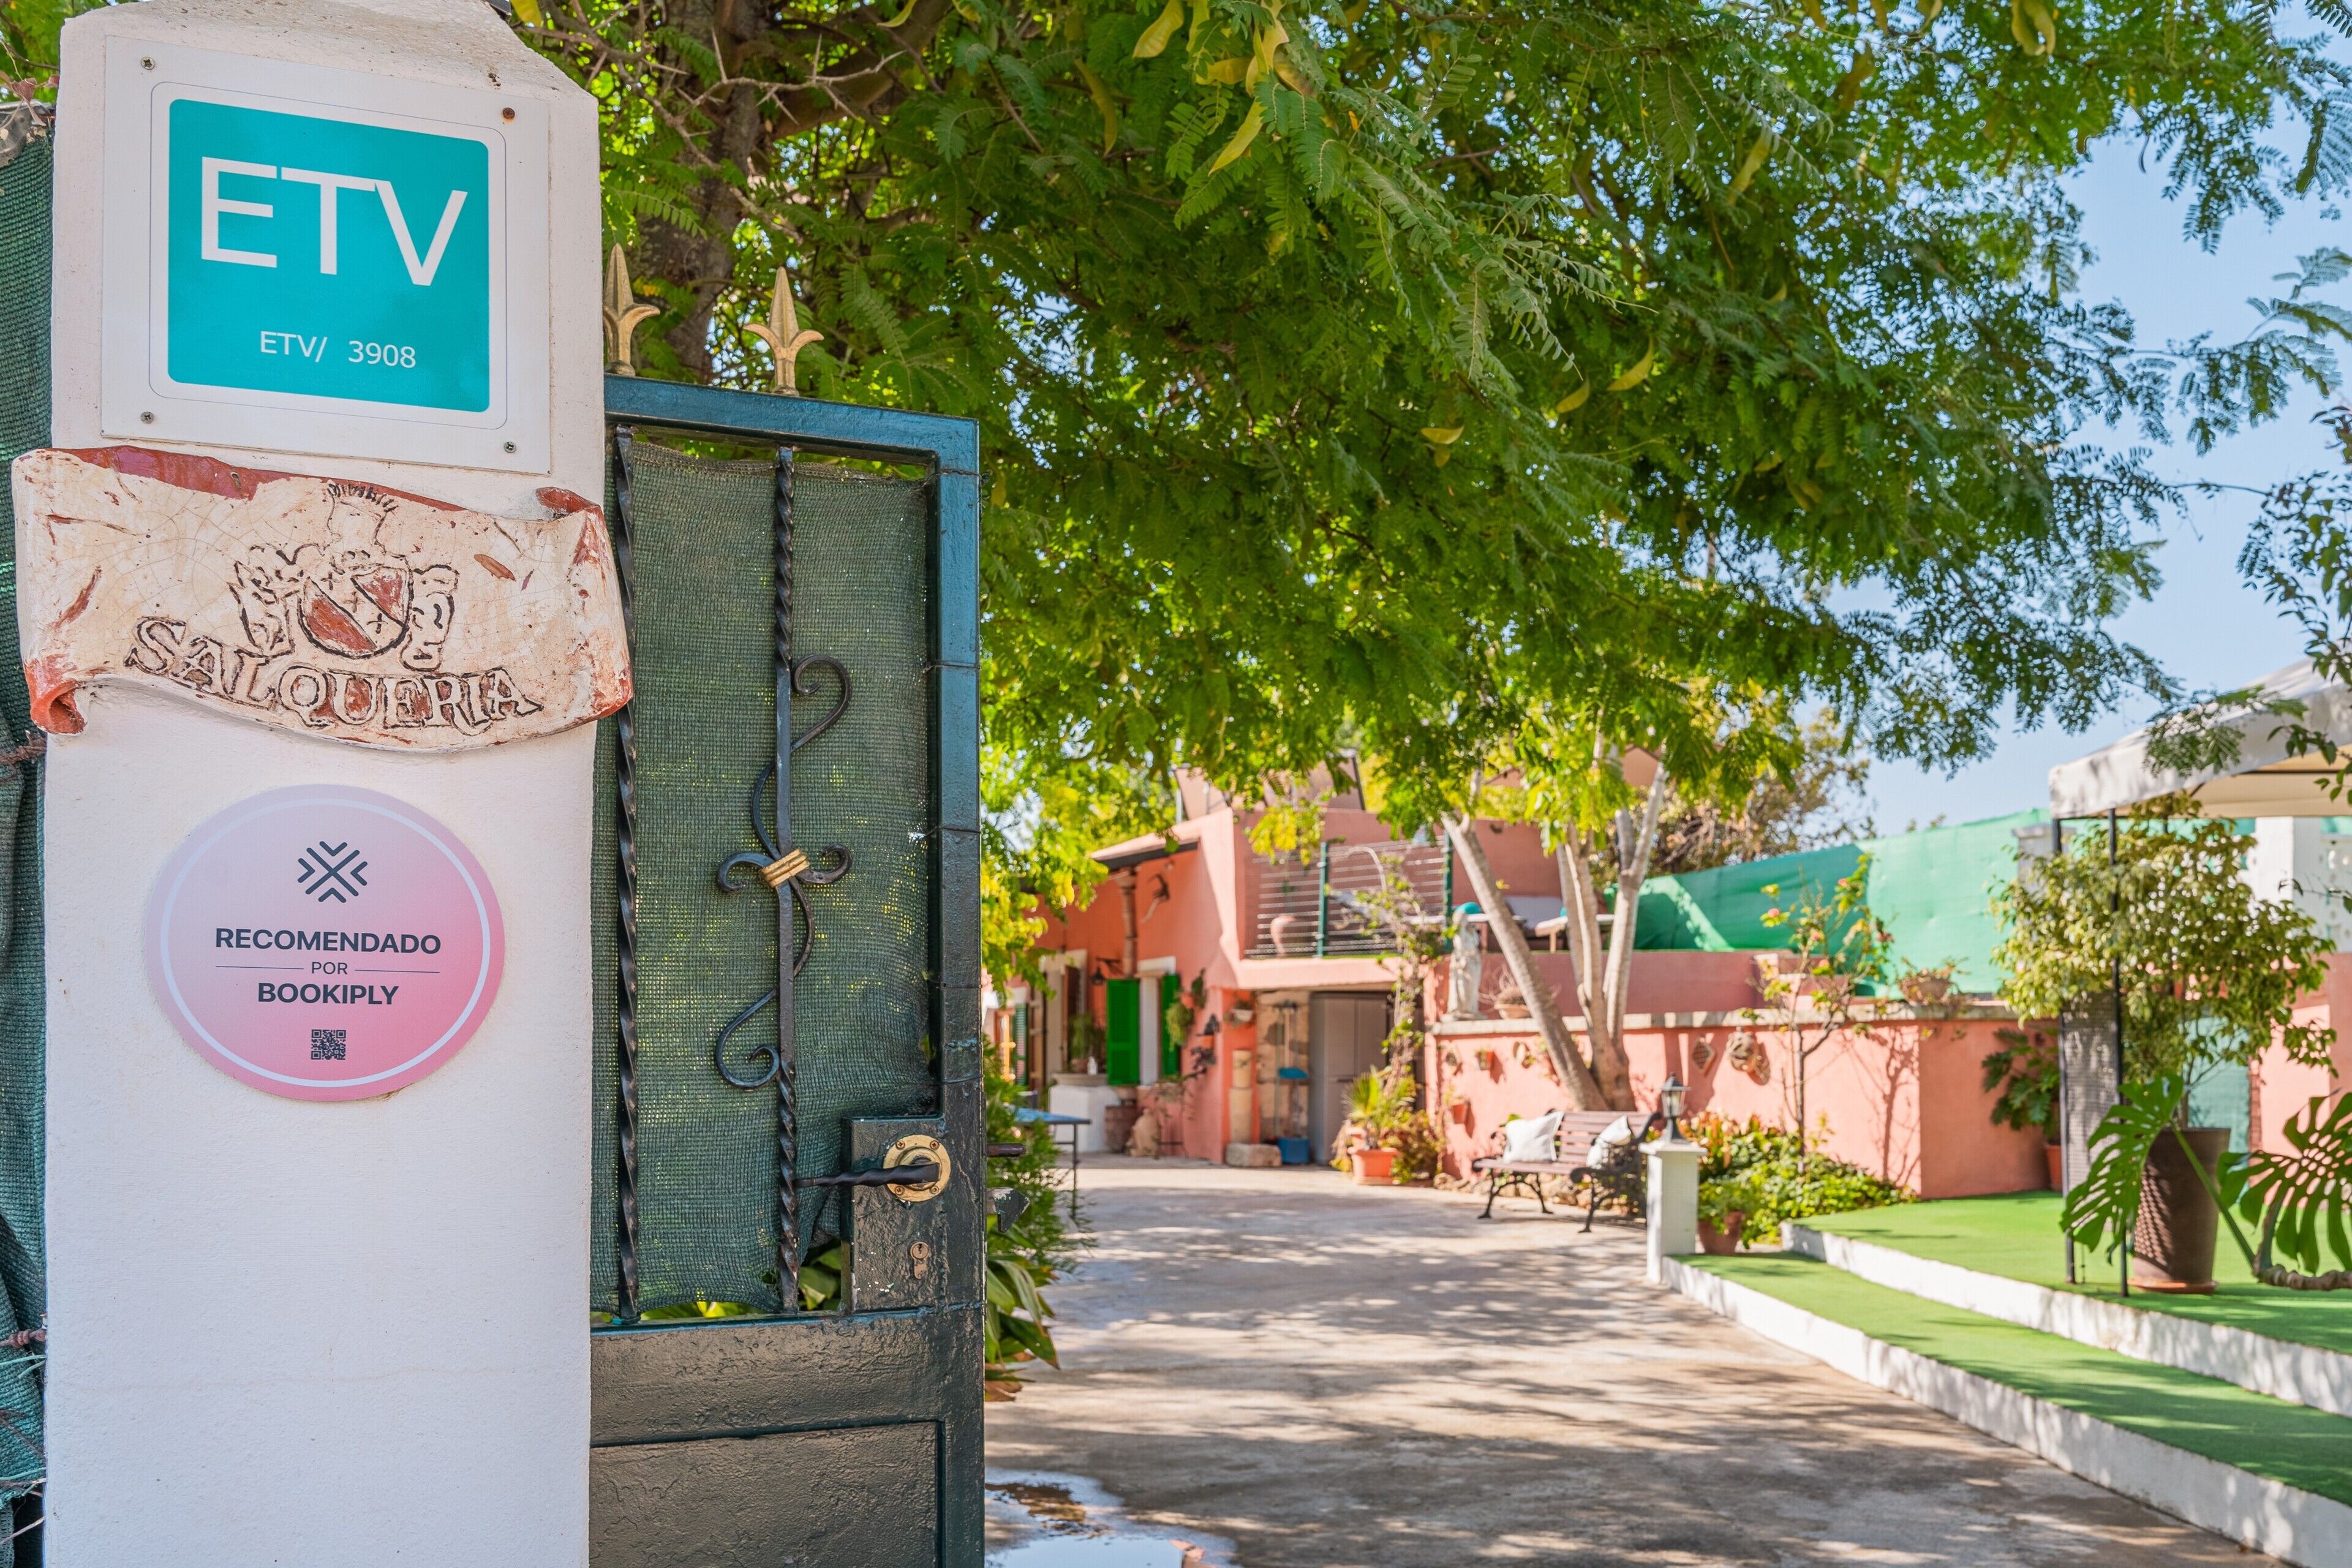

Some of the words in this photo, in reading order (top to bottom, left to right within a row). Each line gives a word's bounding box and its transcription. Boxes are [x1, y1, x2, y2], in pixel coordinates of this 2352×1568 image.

[202, 156, 468, 286] ETV
[260, 331, 327, 363] ETV/
[347, 340, 417, 369] 3908
[126, 616, 543, 734] SALQUERIA
[216, 928, 441, 954] RECOMENDADO
[311, 962, 349, 975] POR
[257, 982, 399, 1005] BOOKIPLY
